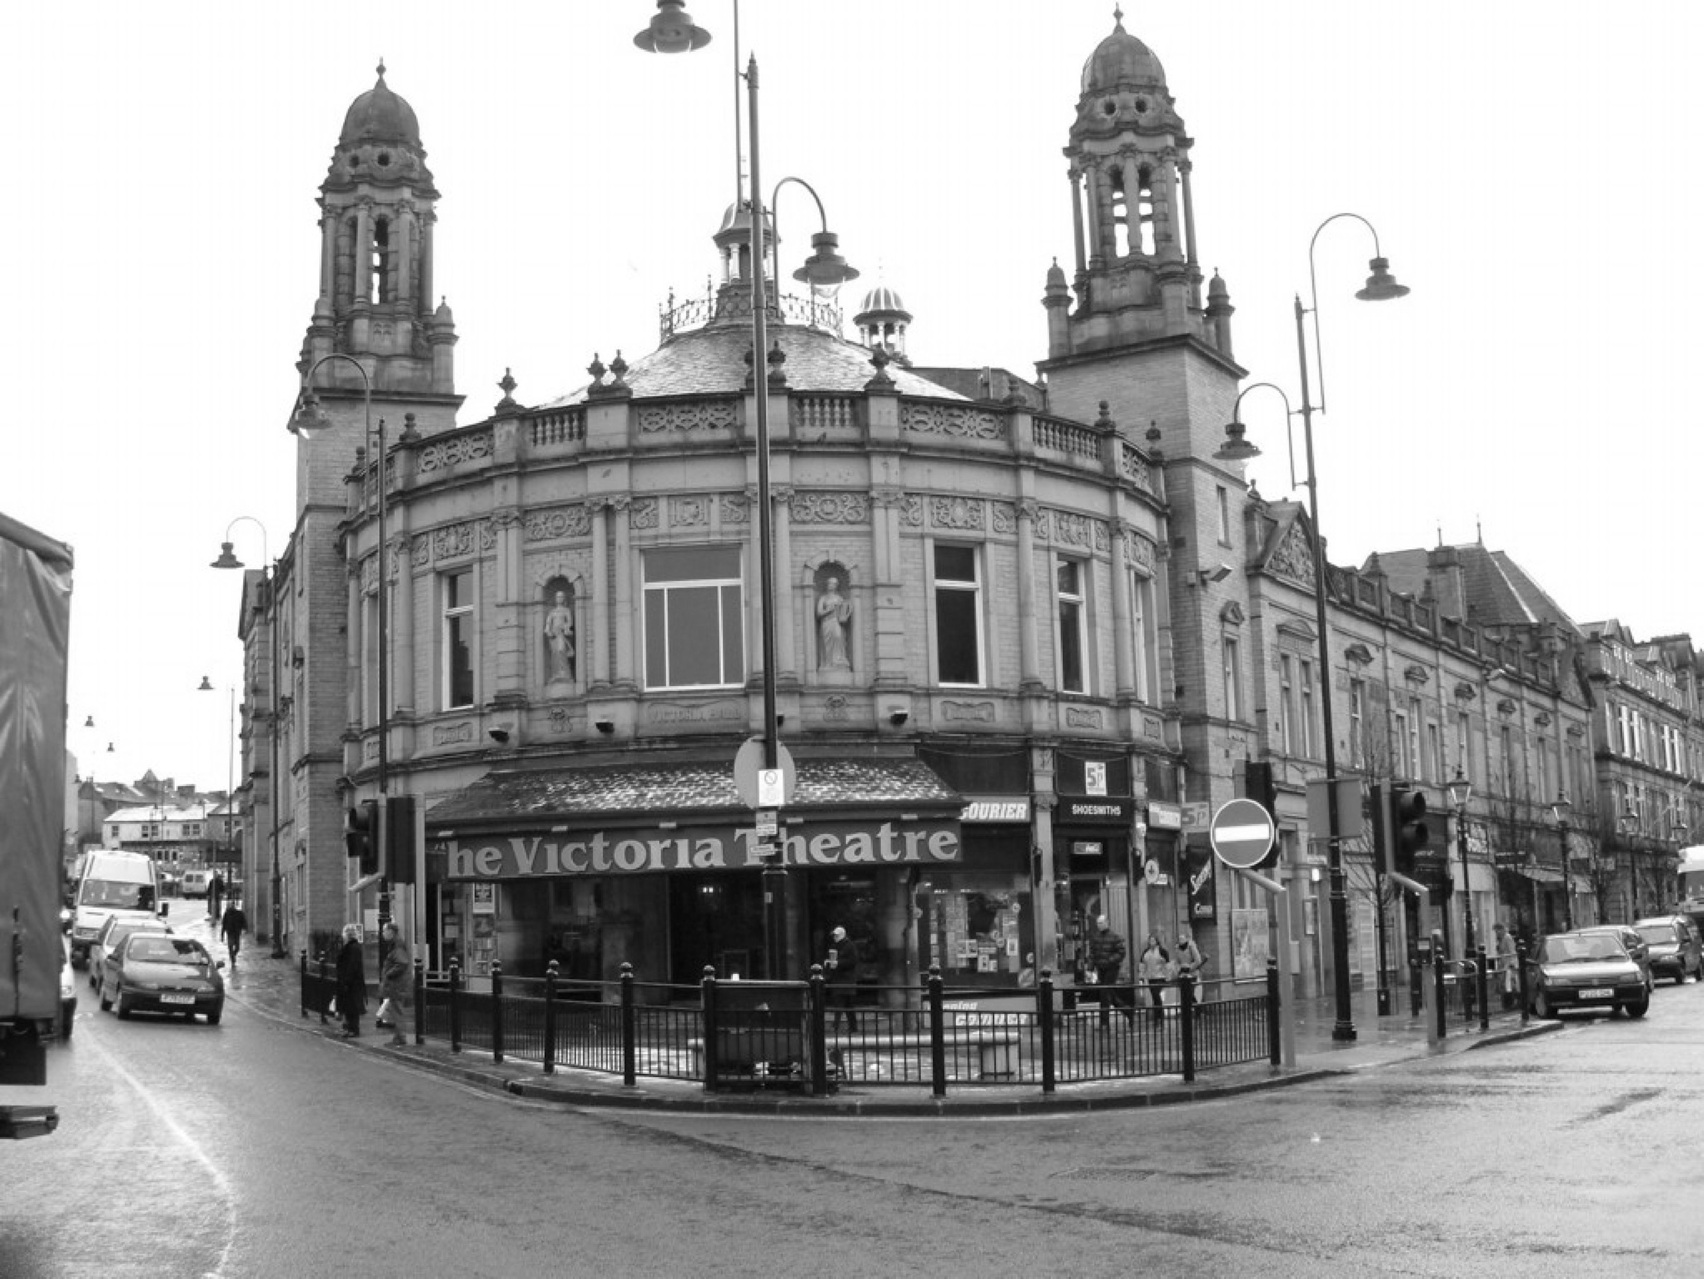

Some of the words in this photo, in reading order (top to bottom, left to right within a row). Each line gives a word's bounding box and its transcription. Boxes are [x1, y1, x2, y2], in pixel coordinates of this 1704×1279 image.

[1072, 804, 1121, 816] SHOESMITHS
[508, 831, 727, 876] Victoria
[734, 822, 959, 867] Theatre
